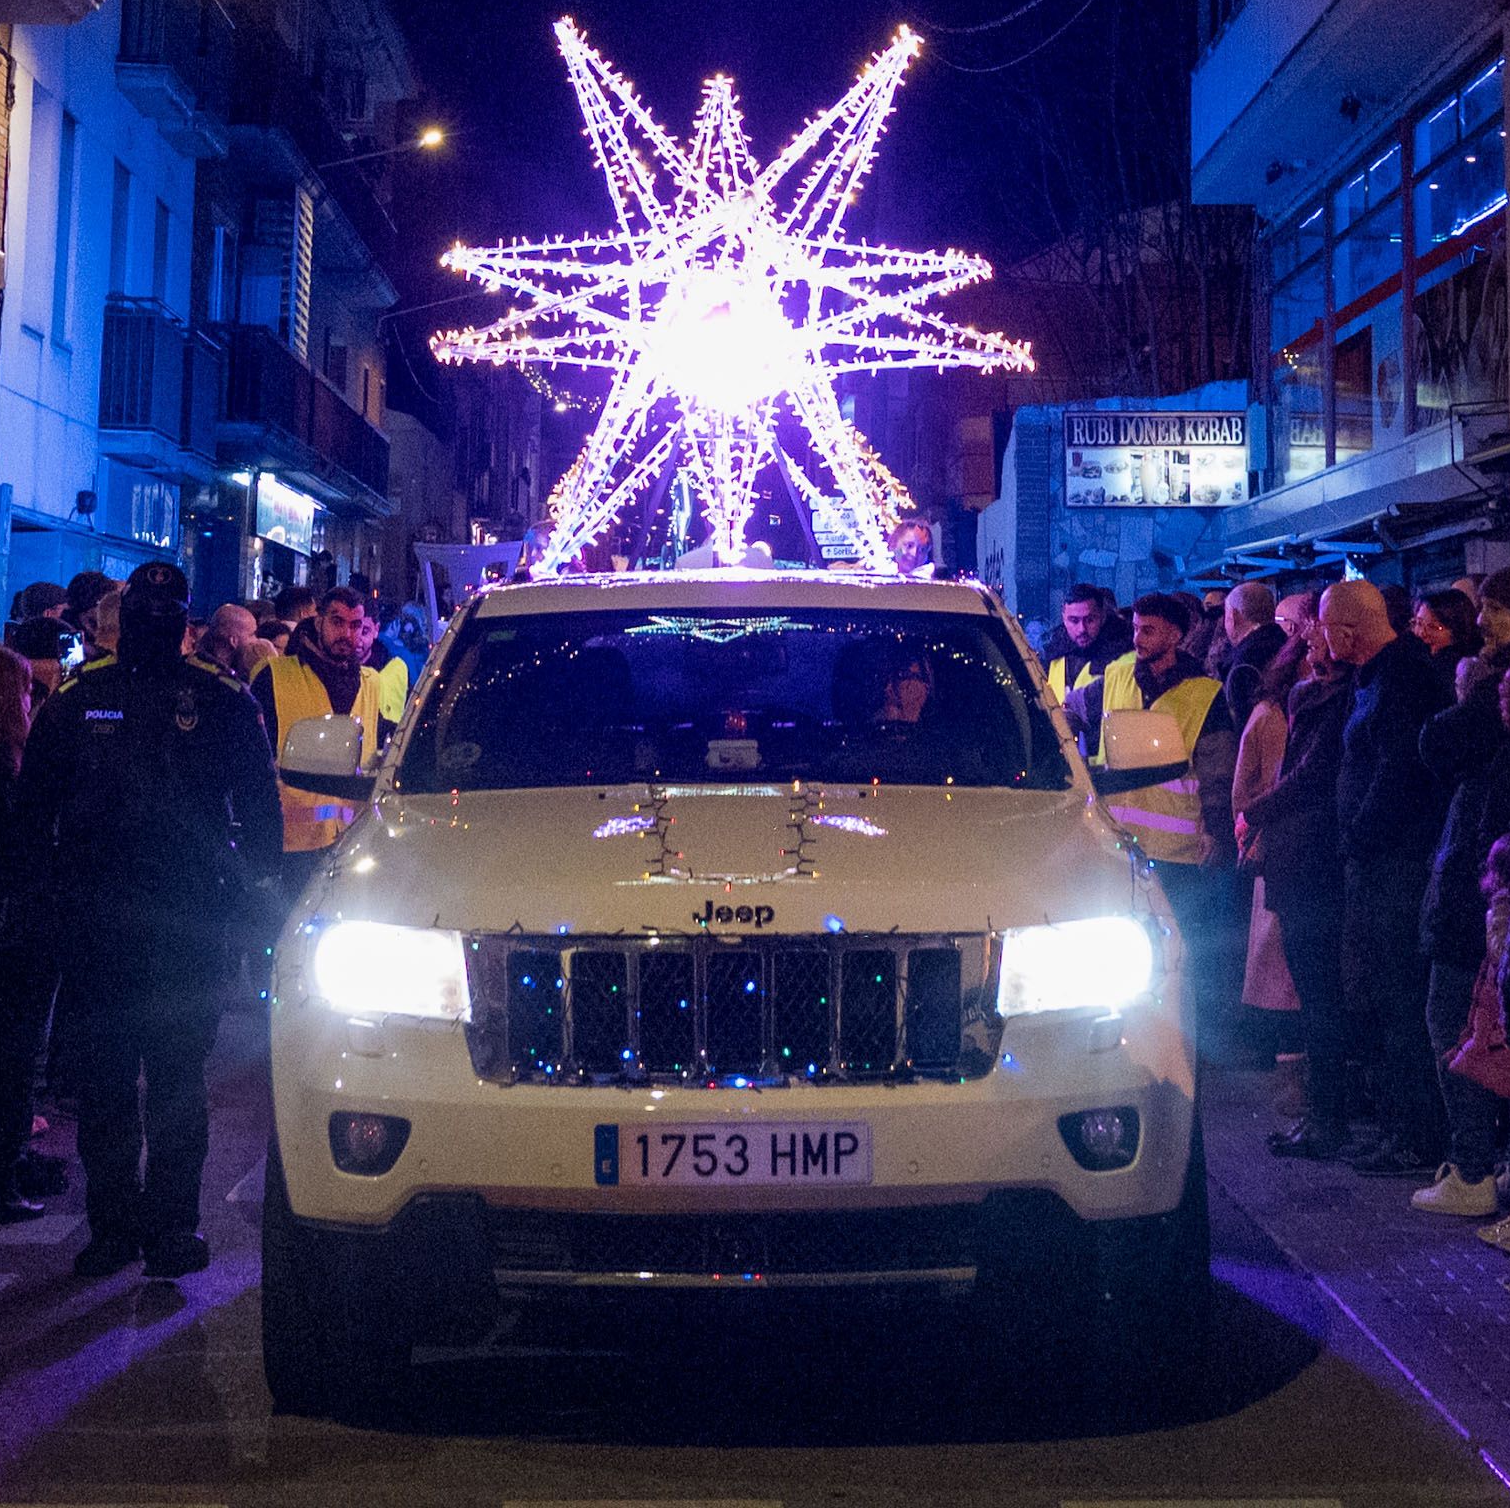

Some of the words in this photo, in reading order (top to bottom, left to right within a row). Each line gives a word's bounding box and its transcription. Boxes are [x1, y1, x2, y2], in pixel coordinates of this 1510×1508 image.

[1073, 417, 1115, 444] RUBI
[1119, 417, 1182, 445] DONER
[1184, 417, 1243, 444] KEBAB
[84, 708, 123, 720] POLICIA
[692, 899, 776, 929] Jeep
[636, 1133, 749, 1177] 1753
[770, 1132, 860, 1176] HMP
